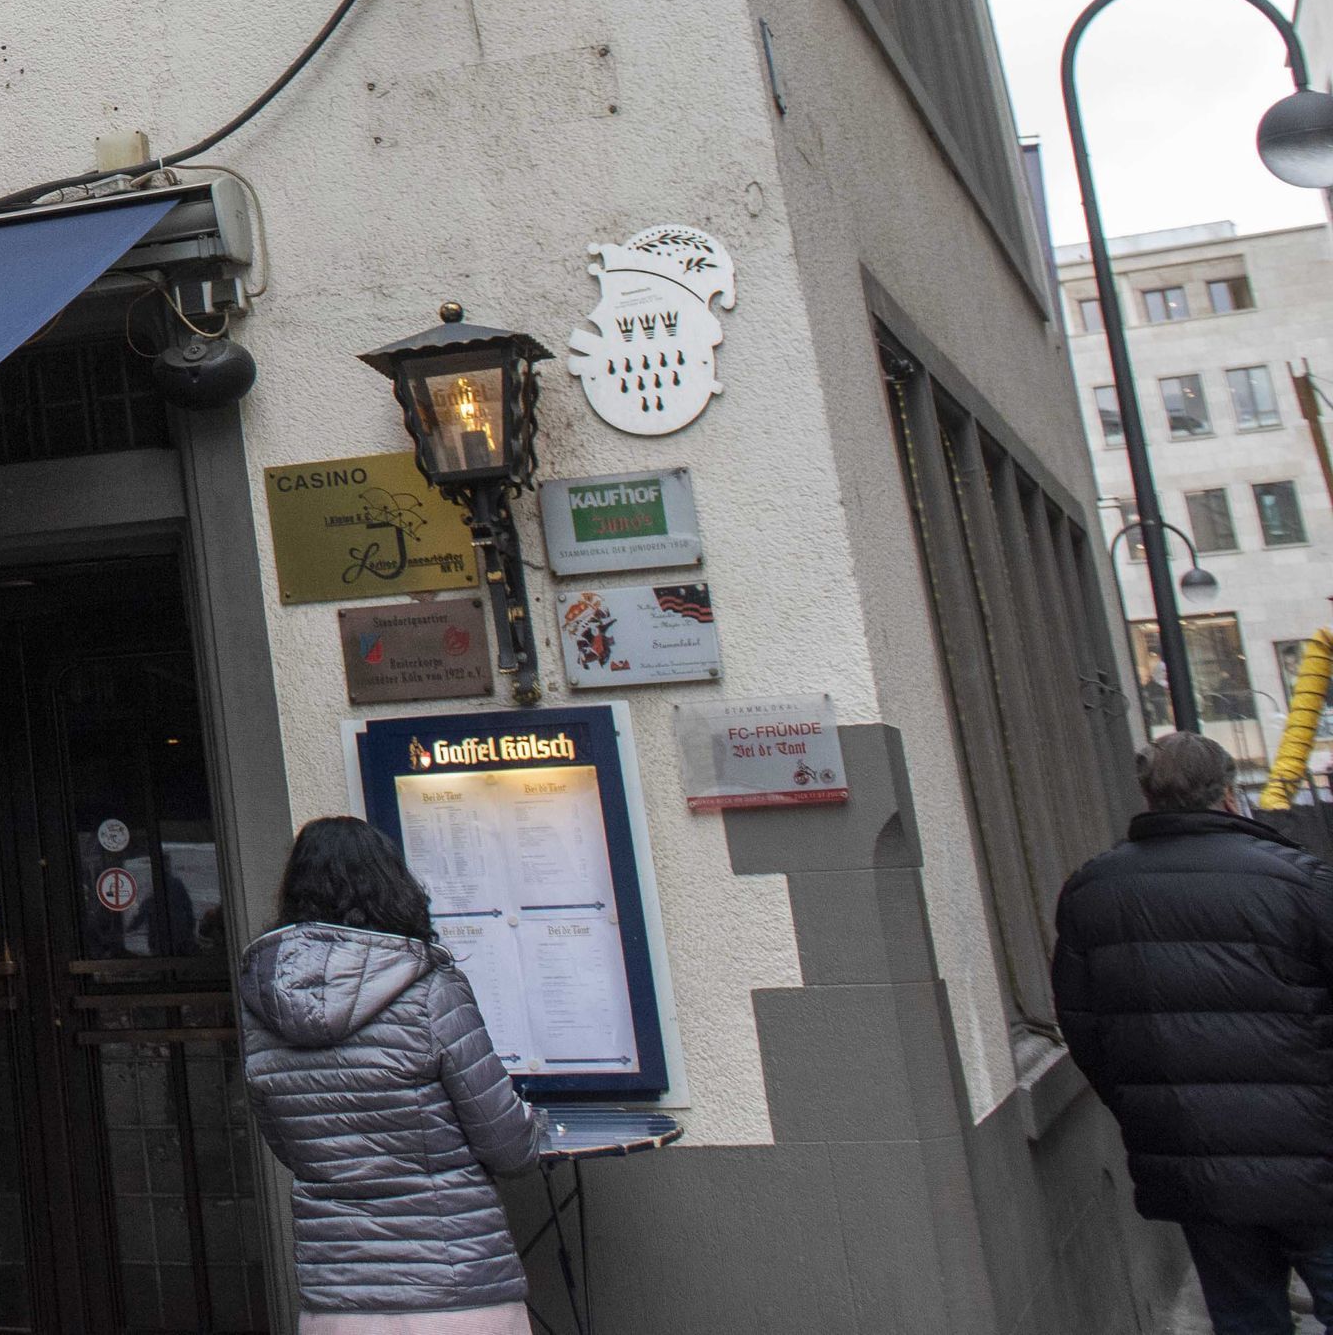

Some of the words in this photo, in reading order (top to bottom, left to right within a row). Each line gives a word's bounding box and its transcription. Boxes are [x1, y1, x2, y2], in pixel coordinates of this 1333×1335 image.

[276, 467, 368, 493] CASINO
[401, 669, 424, 684] Köln
[724, 702, 800, 715] STAMMLOKAL
[728, 721, 822, 741] FC-FRÜNDE
[434, 736, 499, 766] Gaffel
[500, 732, 576, 762] Kölsch
[732, 743, 757, 758] Bei
[776, 741, 808, 756] Tant
[422, 792, 436, 803] Bei
[445, 791, 463, 801] Tant
[548, 926, 562, 936] Bei
[572, 925, 590, 935] Tant
